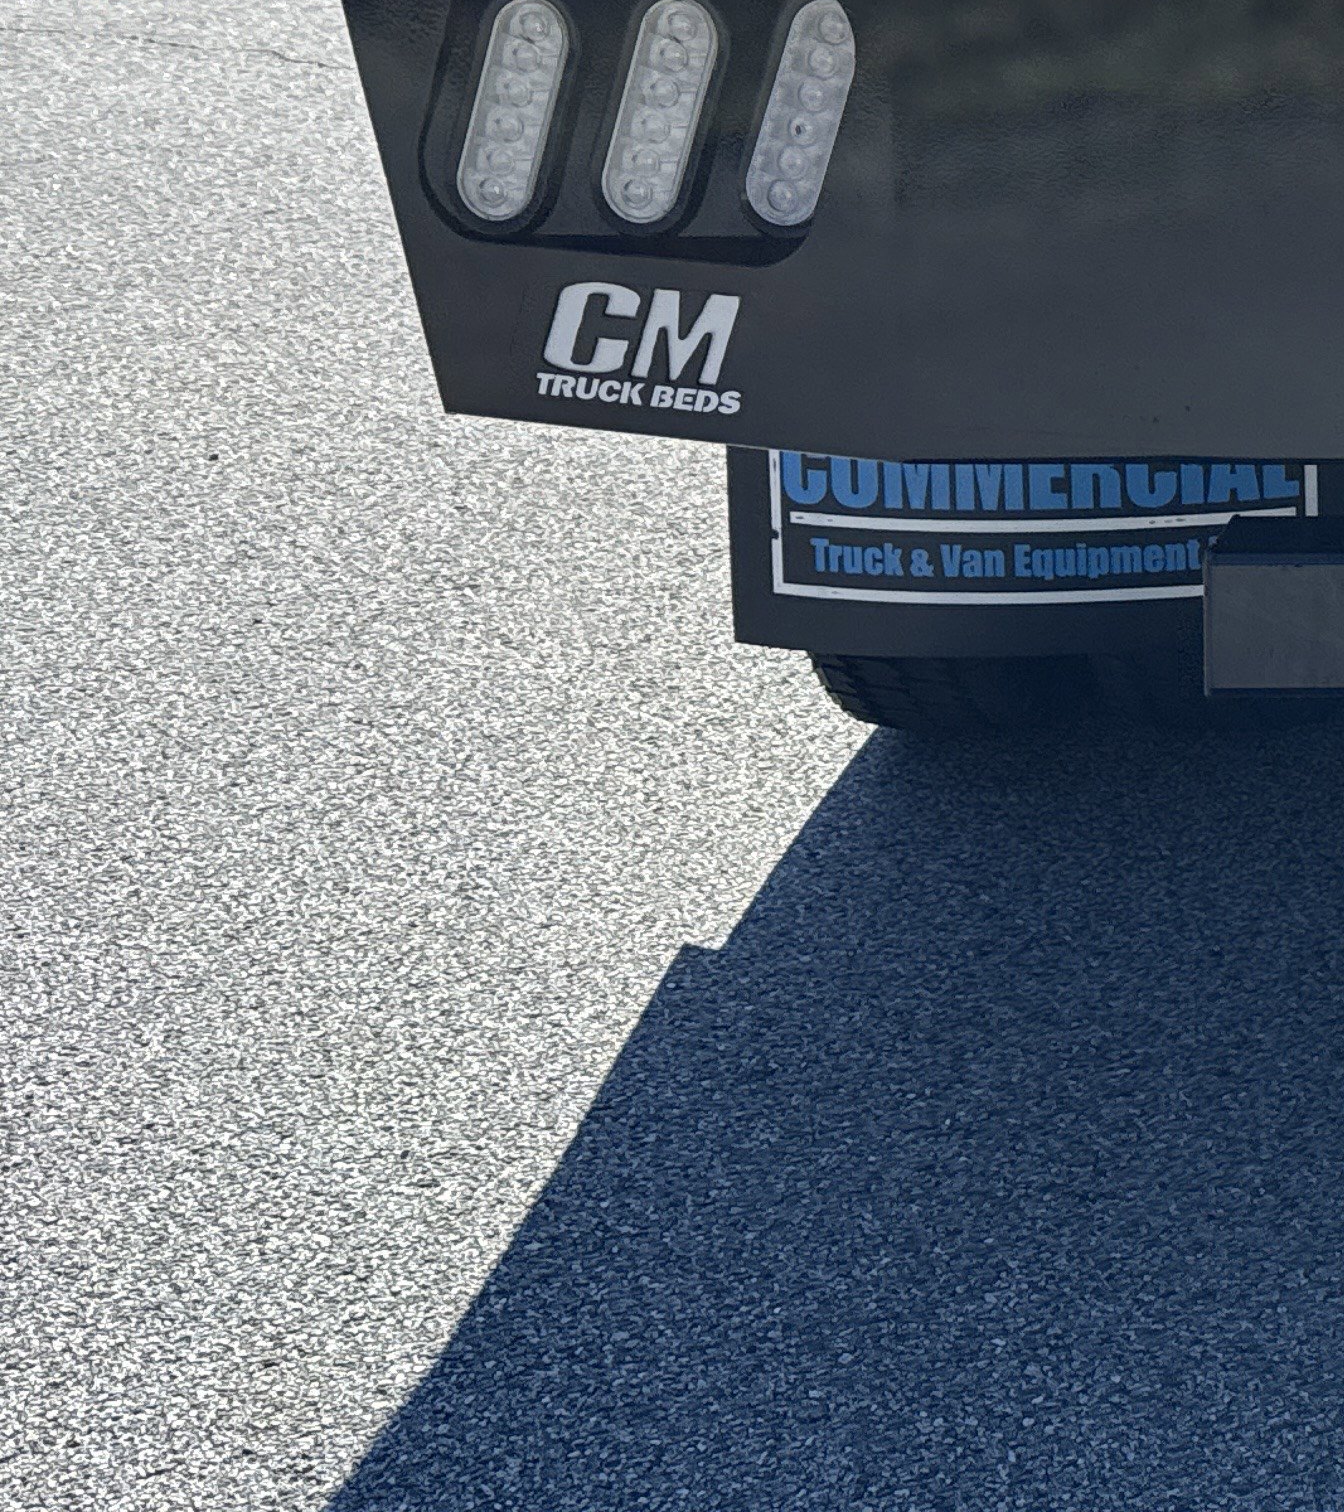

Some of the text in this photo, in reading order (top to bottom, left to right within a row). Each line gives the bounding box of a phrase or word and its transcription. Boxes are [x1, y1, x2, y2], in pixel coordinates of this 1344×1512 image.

[543, 281, 742, 386] CM
[536, 372, 742, 415] TRUCK BEDS
[809, 537, 1200, 582] Truck & Van Equipment
